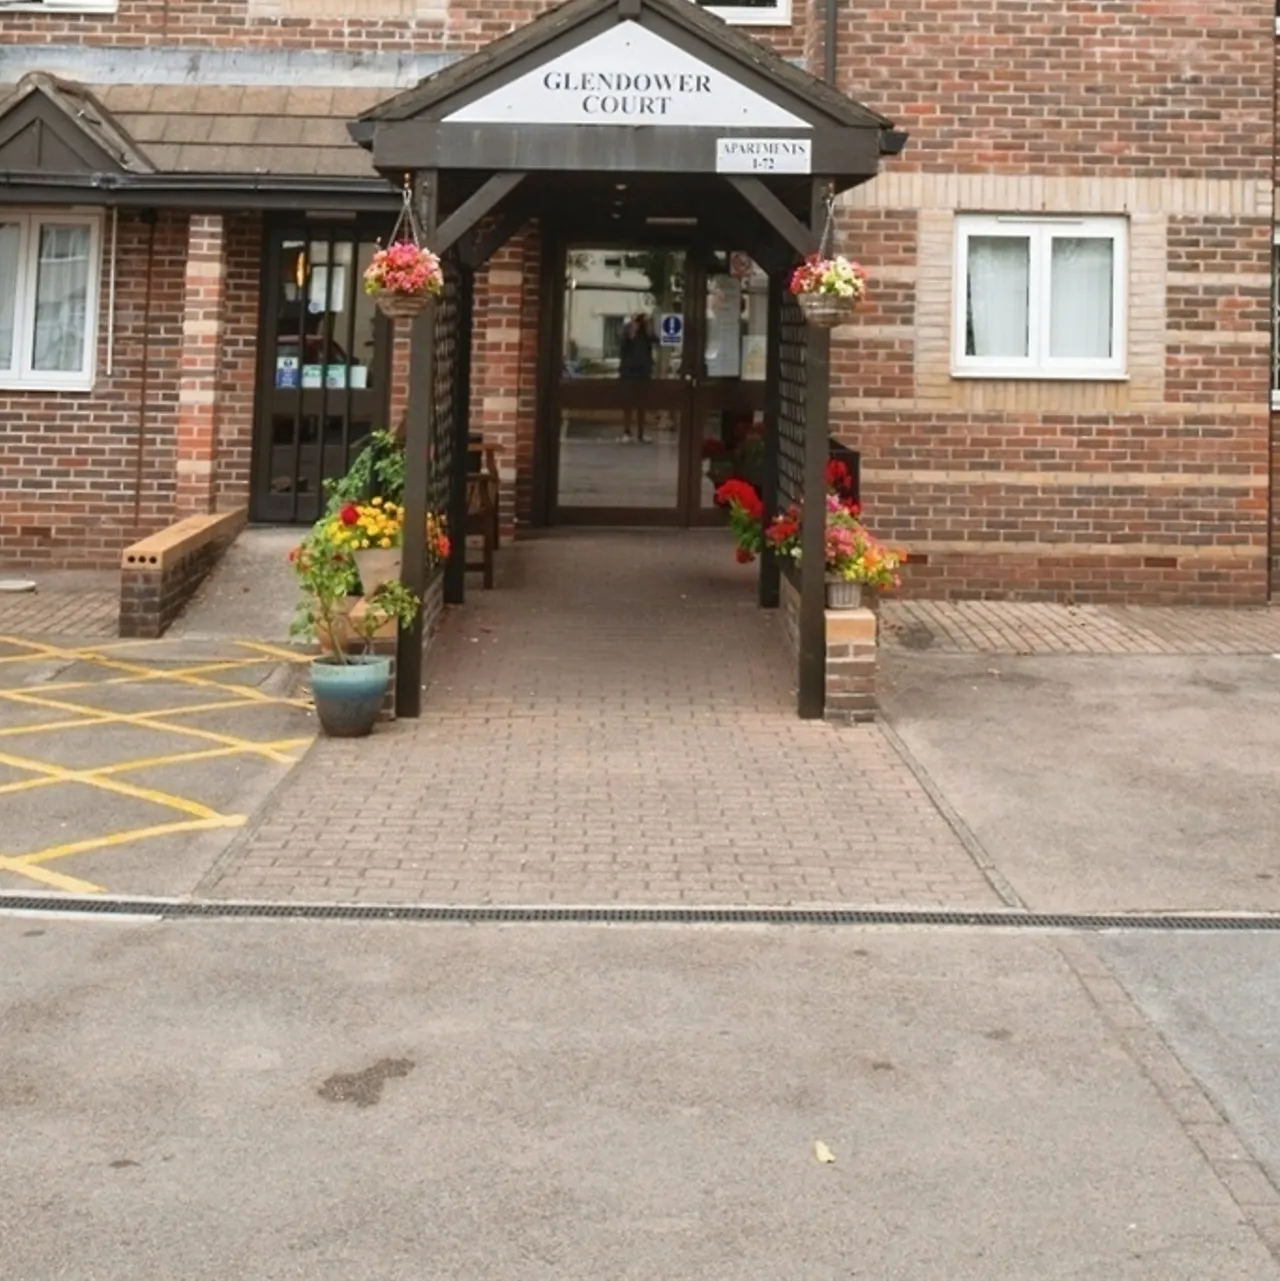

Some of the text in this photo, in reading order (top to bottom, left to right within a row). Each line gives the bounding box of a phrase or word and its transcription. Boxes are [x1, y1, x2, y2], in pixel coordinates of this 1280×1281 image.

[543, 71, 712, 93] GLENDOWER
[582, 94, 672, 115] COURT
[724, 143, 806, 155] APARTMENTS
[752, 157, 775, 170] 1-72
